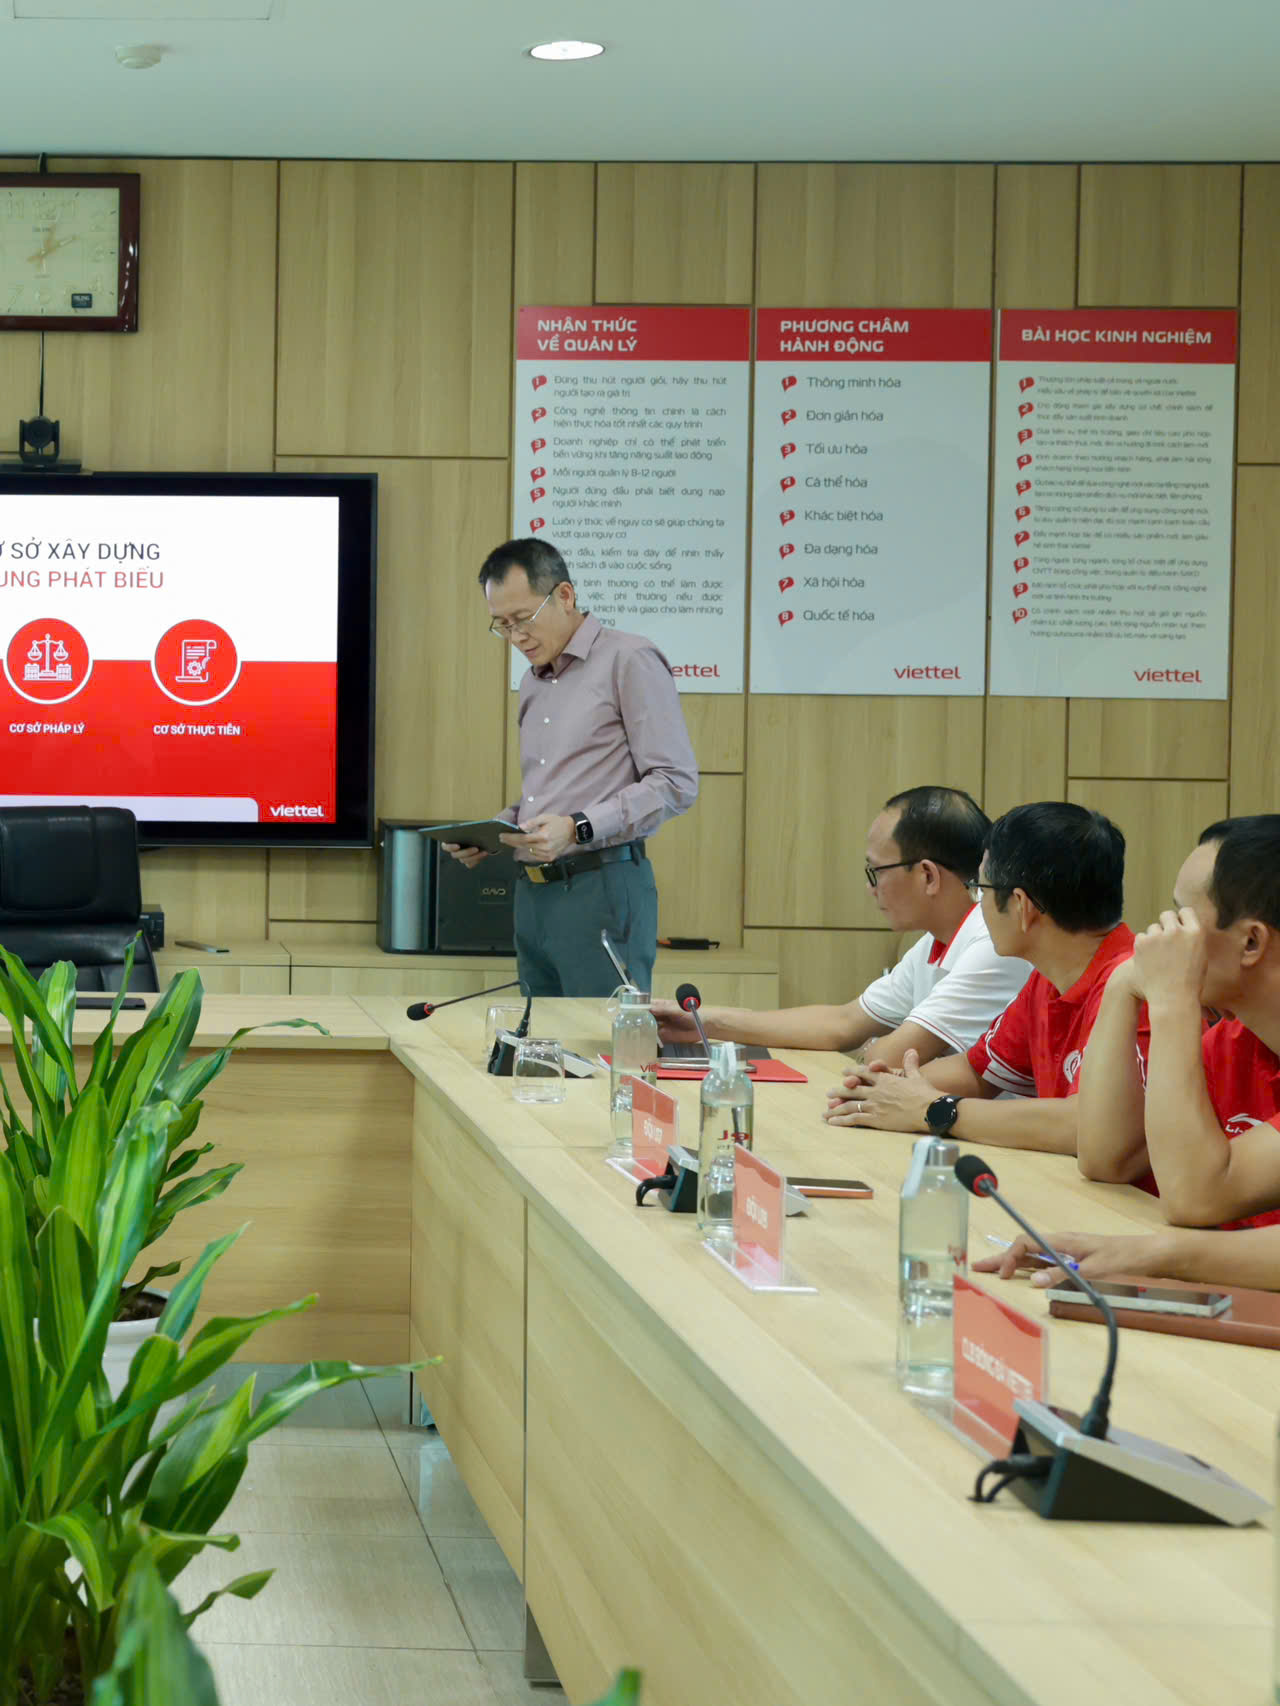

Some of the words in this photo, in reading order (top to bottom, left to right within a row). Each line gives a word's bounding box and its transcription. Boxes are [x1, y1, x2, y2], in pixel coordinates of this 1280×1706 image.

[537, 316, 586, 334] NHẬN
[592, 317, 636, 332] THỨC
[780, 320, 854, 332] PHƯƠNG
[859, 318, 909, 332] CHÂM
[1022, 326, 1050, 341] BÀI
[1056, 330, 1090, 344] HỌC
[1096, 330, 1137, 342] KINH
[1142, 328, 1211, 344] NGHIỆM
[537, 334, 559, 351] VỀ
[564, 336, 613, 351] QUẢN
[618, 336, 637, 351] LÝ
[780, 337, 829, 352] HÀNH
[834, 337, 884, 354] ĐỘNG
[806, 376, 845, 390] Thông
[848, 377, 876, 388] minh
[878, 377, 902, 388] hóa
[806, 410, 831, 421] Đơn
[834, 409, 858, 424] giản
[861, 411, 884, 422] hóa
[806, 442, 825, 454] Tối
[828, 444, 842, 455] ưu
[845, 443, 868, 455] hóa
[805, 476, 821, 488] Cá
[824, 474, 842, 488] thể
[845, 477, 868, 488] hóa
[804, 510, 833, 521] Khác
[837, 510, 858, 522] biệt
[861, 510, 884, 522] hóa
[12, 537, 41, 559] SỞ
[48, 537, 89, 559] XÂY
[99, 542, 160, 563] DỰNG
[804, 543, 821, 554] Đa
[824, 544, 853, 557] dạng
[856, 544, 878, 555] hóa
[49, 568, 105, 588] PHÁT
[115, 567, 163, 588] BIỂU
[803, 577, 819, 588] Xã
[822, 577, 840, 589] hội
[842, 577, 865, 588] hóa
[802, 609, 834, 621] Quốc
[838, 609, 850, 621] tế
[852, 610, 875, 622] hóa
[672, 664, 720, 678] ettel
[894, 666, 960, 679] viettel
[1134, 669, 1201, 682] viettel
[9, 724, 25, 732] CƠ
[27, 722, 42, 733] SỞ
[43, 722, 71, 734] PHÁP
[74, 722, 85, 734] LÝ
[154, 725, 169, 734] CƠ
[171, 723, 186, 734] SỞ
[188, 725, 215, 736] THỰC
[218, 723, 240, 735] TIỄN
[270, 805, 324, 816] viettel
